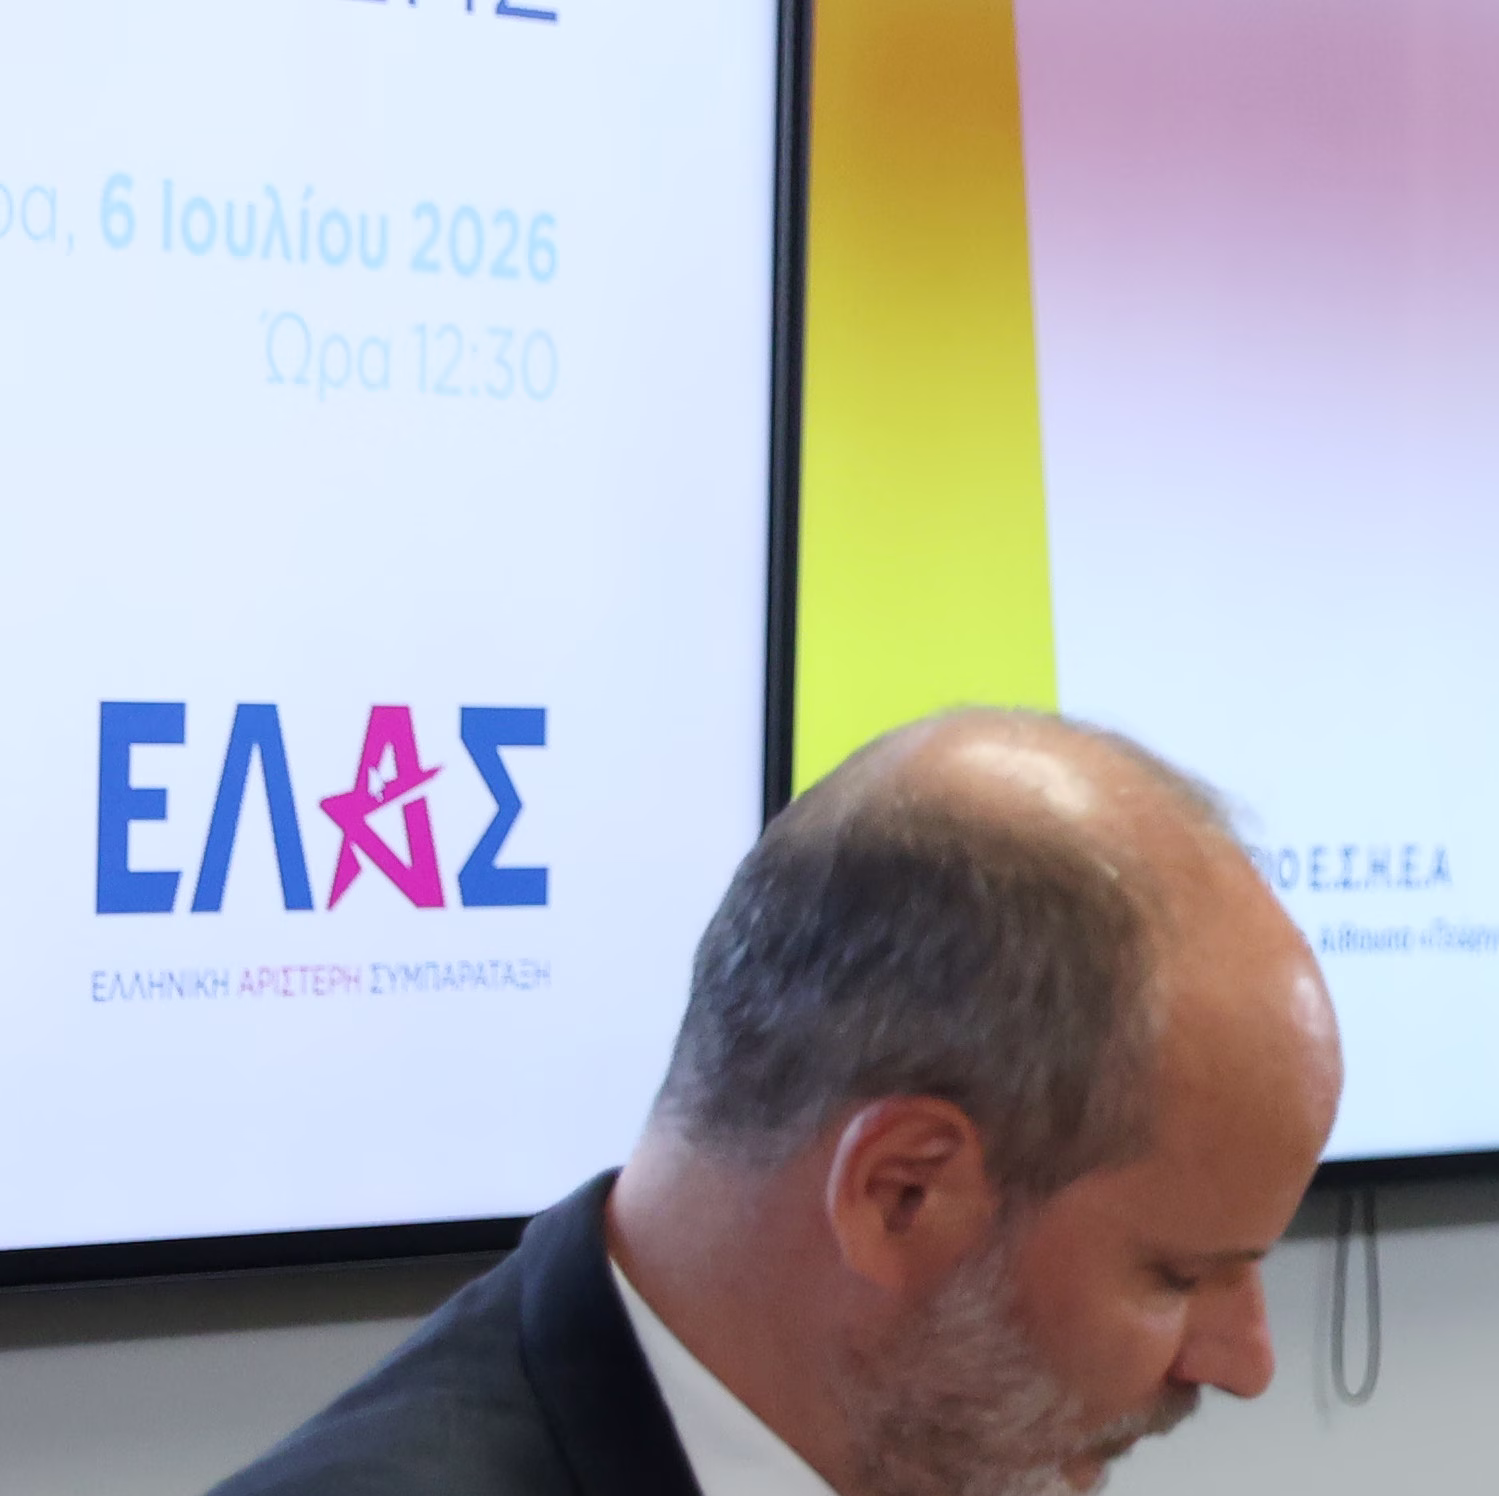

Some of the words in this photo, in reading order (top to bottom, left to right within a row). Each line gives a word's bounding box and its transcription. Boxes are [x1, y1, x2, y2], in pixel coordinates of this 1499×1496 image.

[100, 172, 136, 250] 6
[161, 179, 389, 270] Ιουλίου
[409, 201, 558, 284] 2026
[260, 310, 392, 402] Ώρα
[412, 323, 559, 402] 12:30
[95, 701, 549, 914] ΕΛΑΣ
[91, 969, 230, 1003] ΕΛΛΗΝΙΚΗ
[238, 964, 362, 998] ΑΡΙΣΤΕΡΗ
[368, 959, 551, 996] ΣΥΜΠΑΡΑΤΑΞΗ
